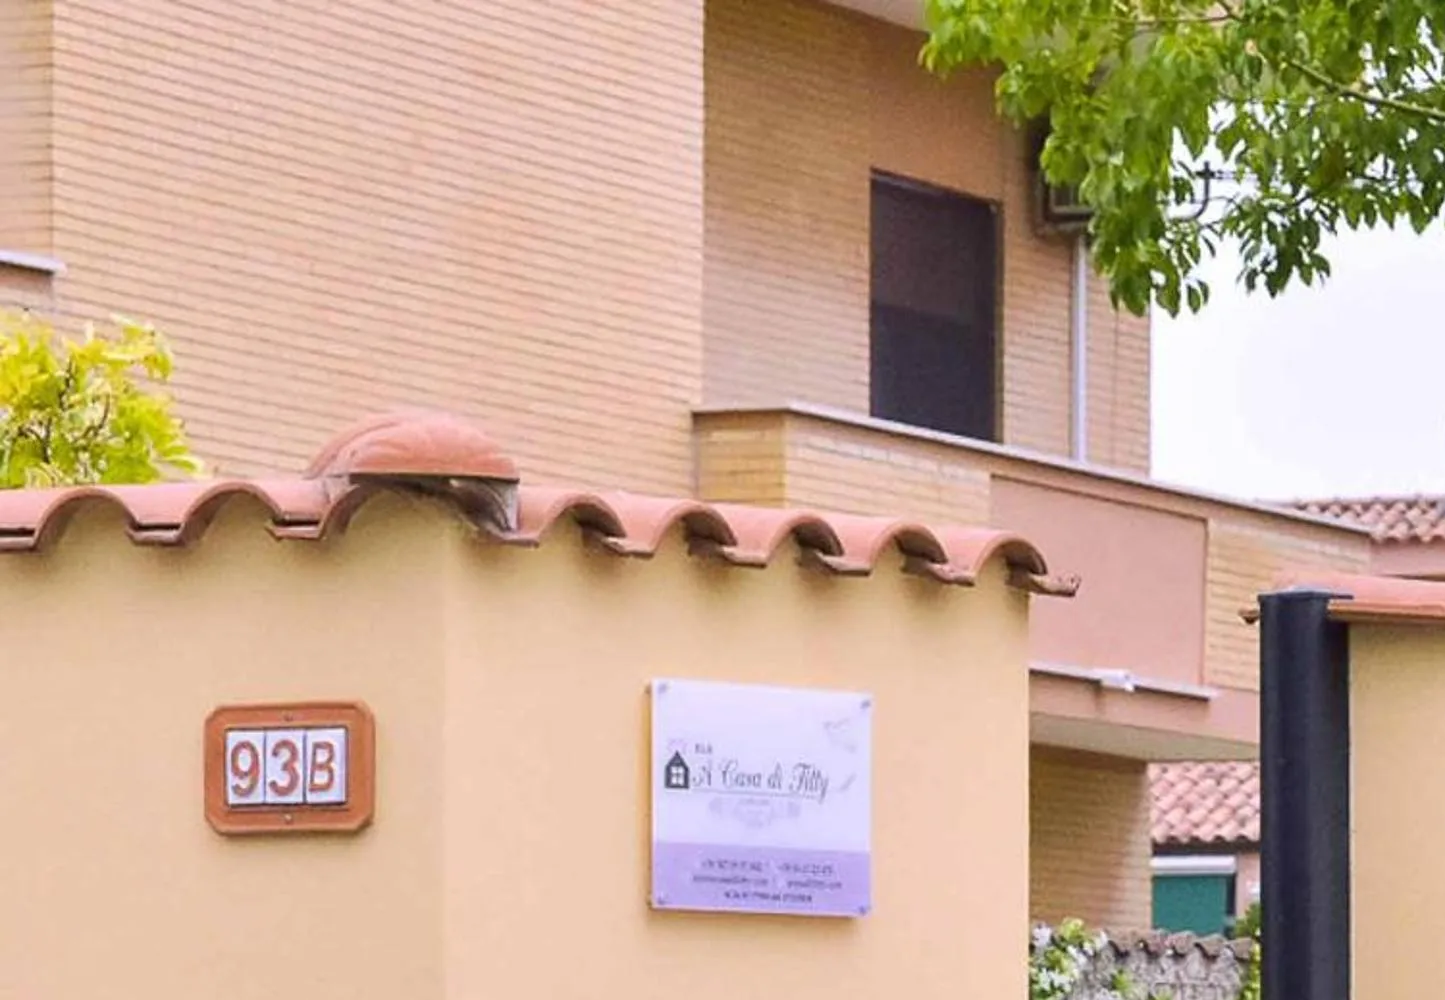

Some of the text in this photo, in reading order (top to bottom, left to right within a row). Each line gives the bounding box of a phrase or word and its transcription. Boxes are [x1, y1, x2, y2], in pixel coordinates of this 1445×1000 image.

[229, 739, 336, 798] 93B
[718, 758, 762, 788] Casa
[767, 761, 783, 789] di
